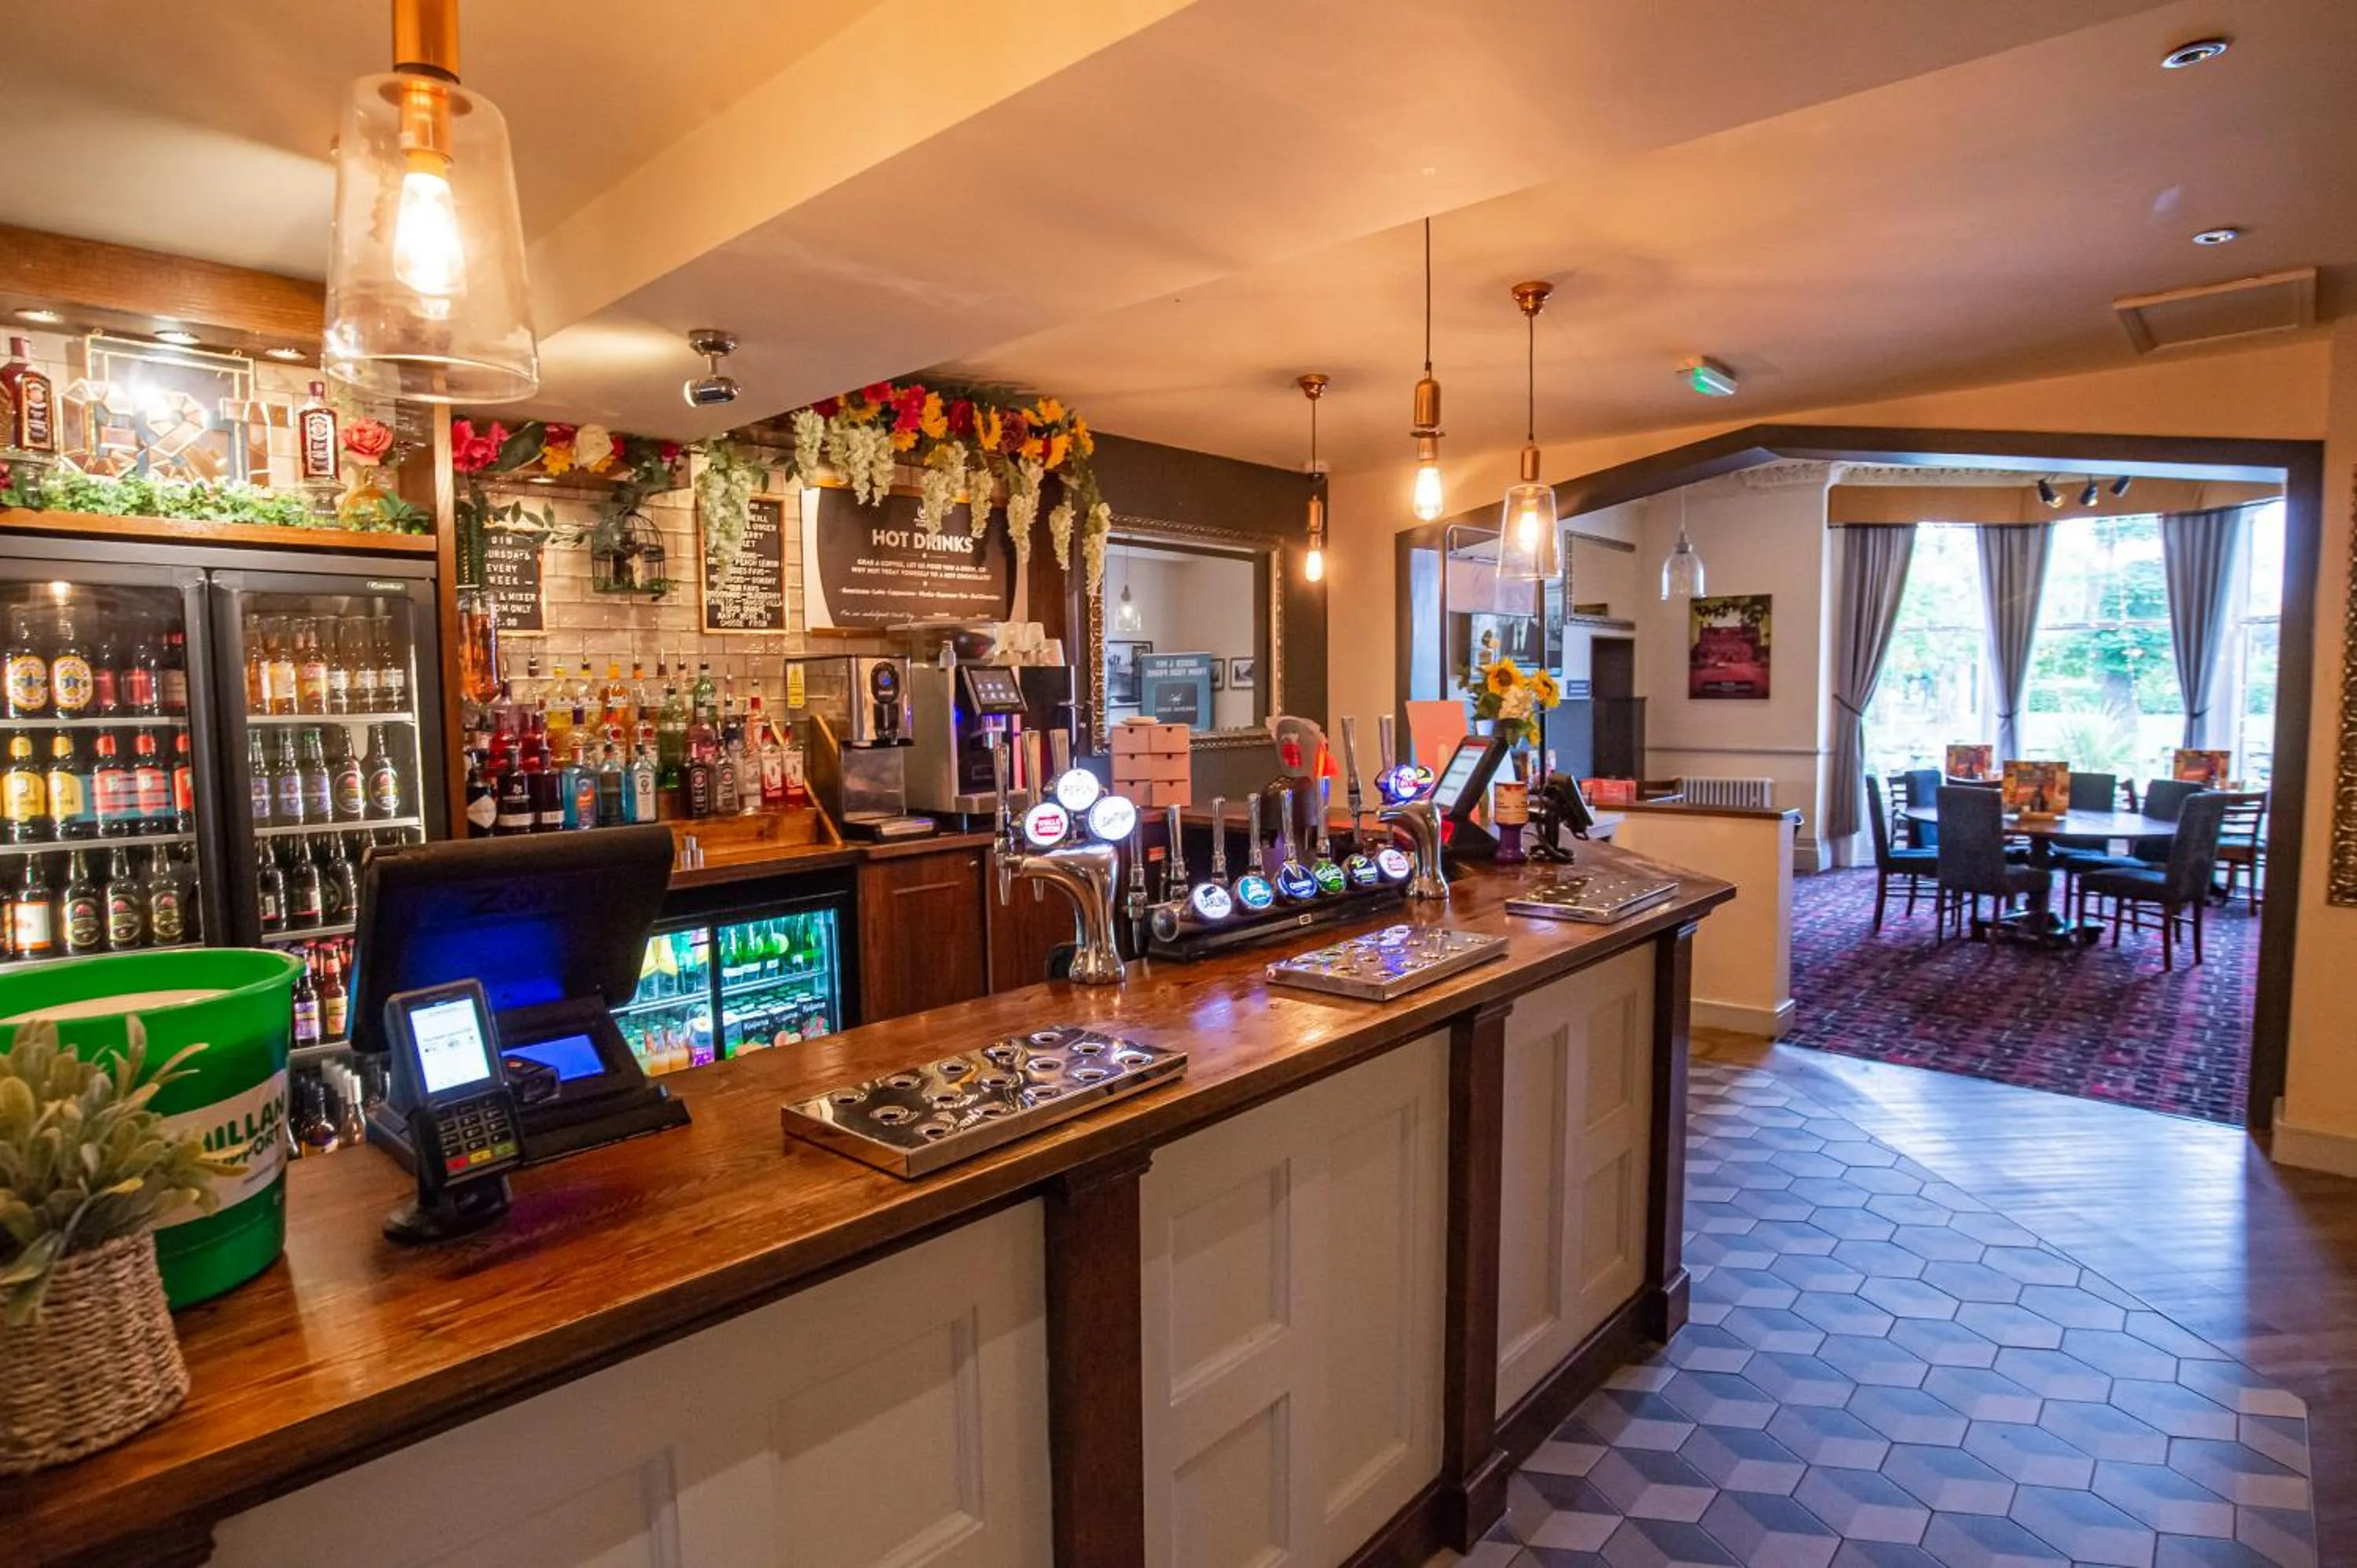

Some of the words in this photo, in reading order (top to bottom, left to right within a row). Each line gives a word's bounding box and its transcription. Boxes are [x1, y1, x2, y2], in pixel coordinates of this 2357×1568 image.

[871, 529, 909, 548] HOT
[913, 532, 974, 554] DRINKS
[486, 563, 518, 573] EVERY
[488, 576, 519, 585] WEEK
[508, 592, 536, 602] MIXER
[510, 604, 532, 614] ONLY
